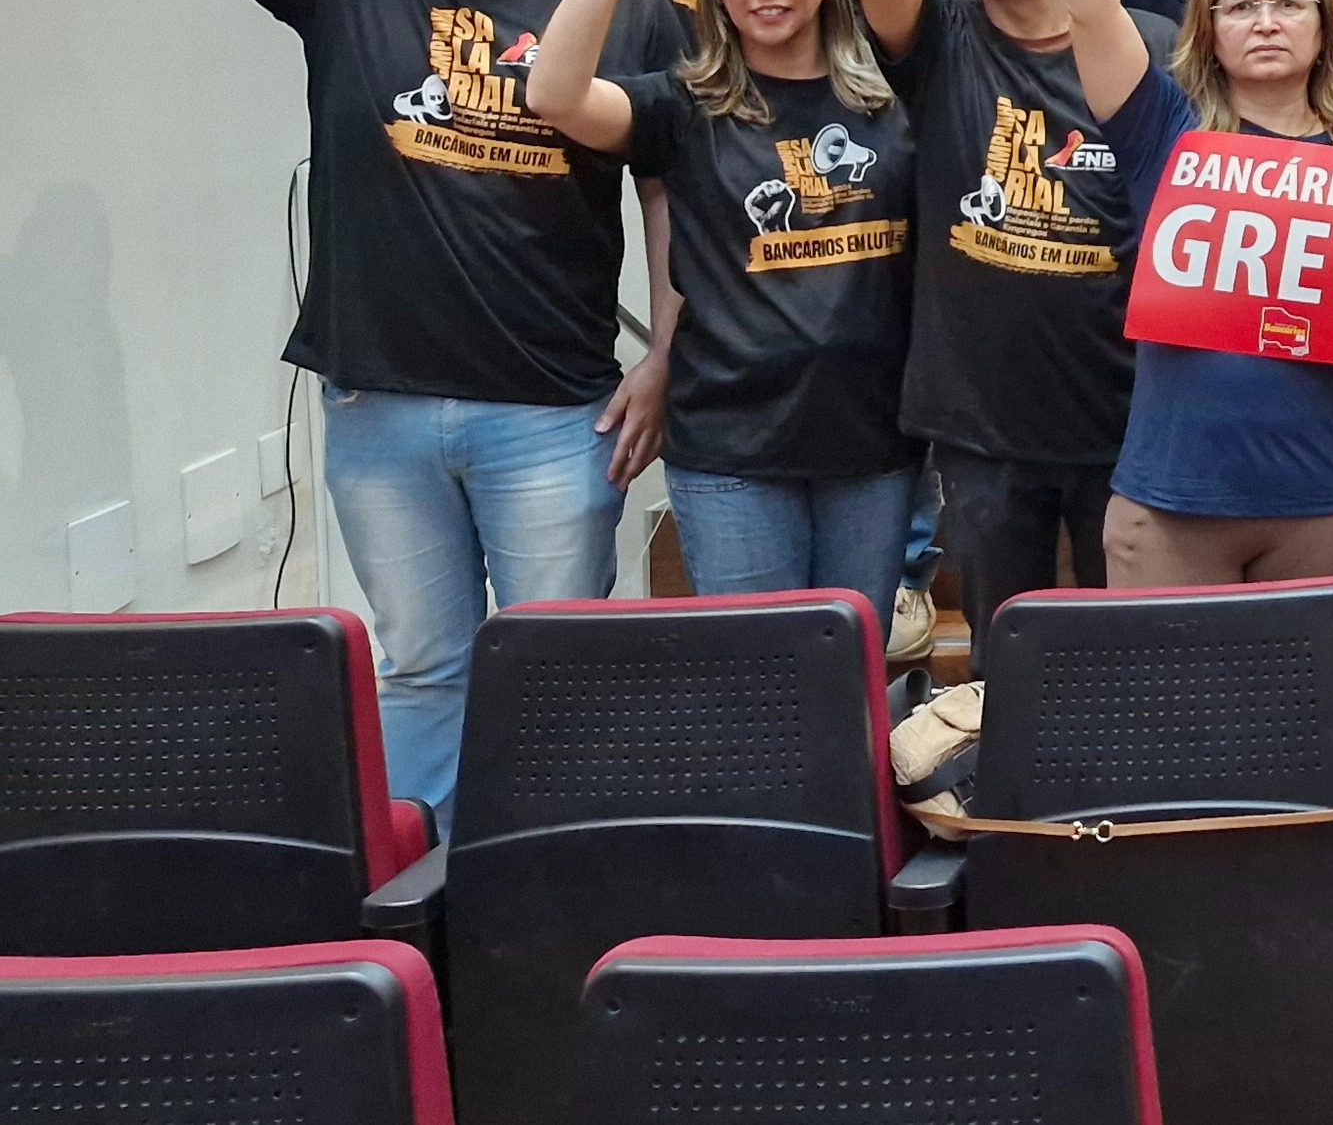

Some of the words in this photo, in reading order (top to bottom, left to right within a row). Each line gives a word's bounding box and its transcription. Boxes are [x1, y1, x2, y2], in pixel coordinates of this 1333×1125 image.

[453, 7, 495, 42] SA
[451, 35, 491, 75] LA
[447, 71, 522, 115] RIAL
[414, 129, 486, 160] BANCÁRIOS
[489, 146, 512, 162] EM
[514, 150, 552, 168] LUTA!
[1010, 132, 1042, 176] LA
[1072, 151, 1117, 168] FNB
[800, 175, 833, 196] RIAL
[1004, 169, 1071, 216] RIAL
[846, 234, 866, 253] EM
[975, 230, 1038, 260] BANCÁRIOS
[1040, 246, 1063, 263] EM
[1065, 250, 1100, 266] LUTA!
